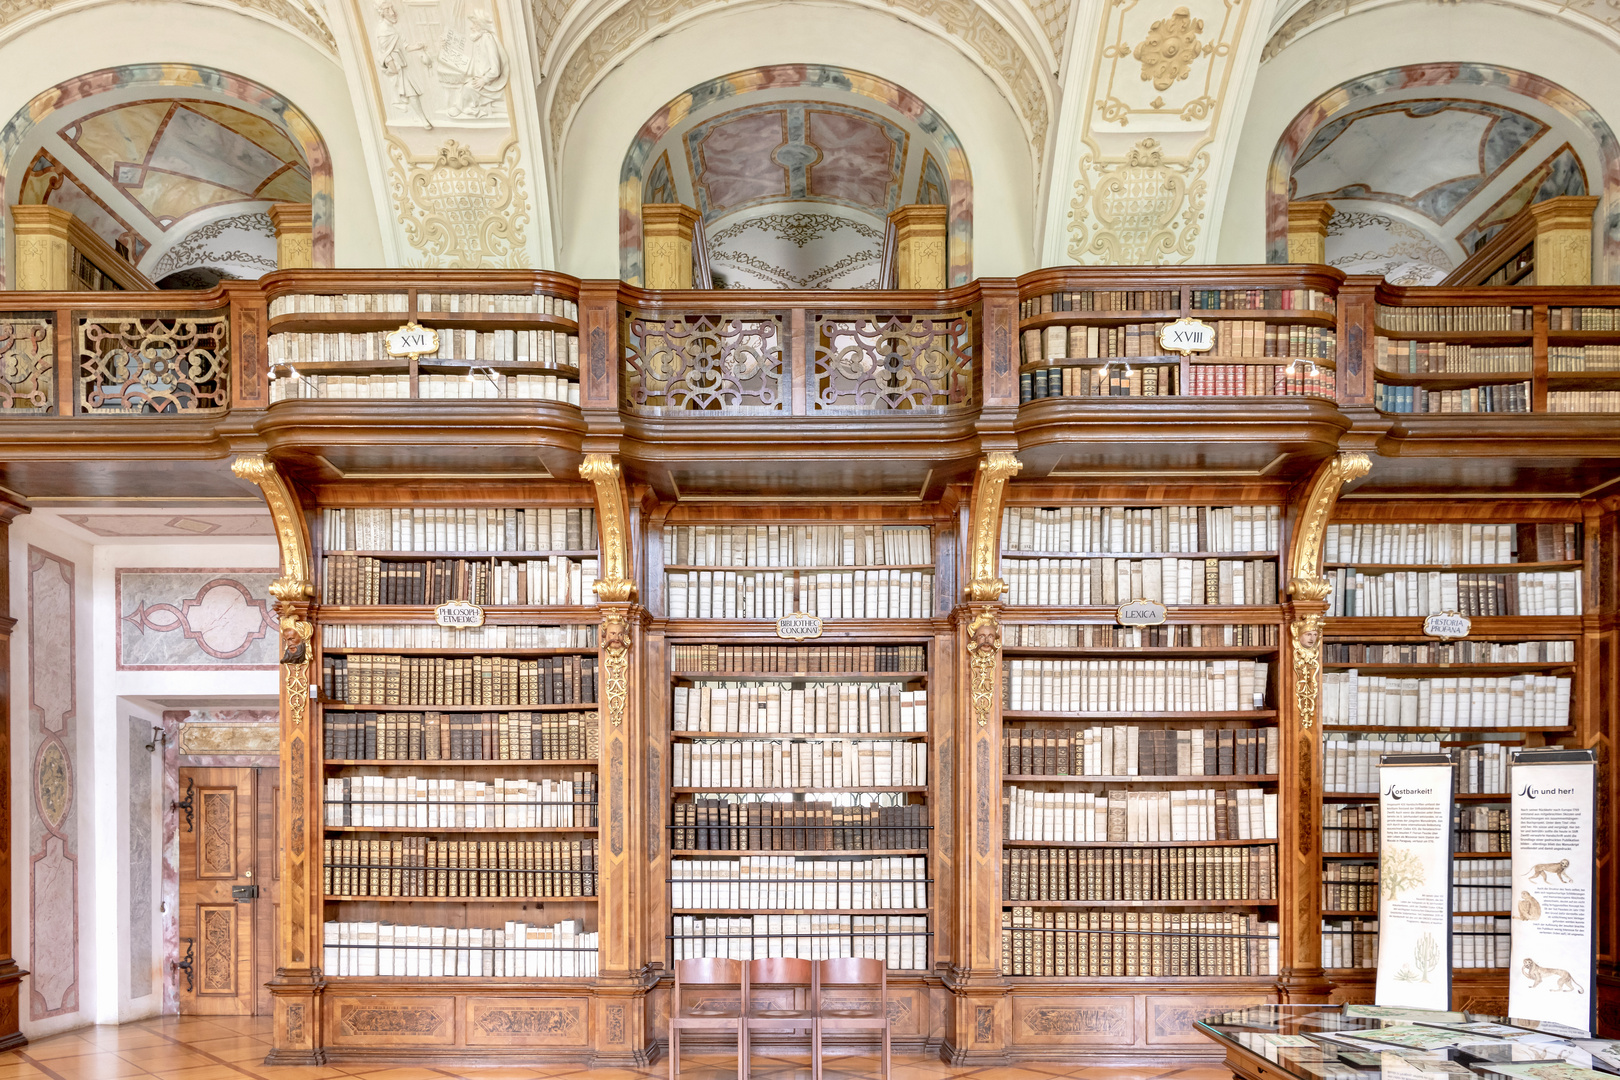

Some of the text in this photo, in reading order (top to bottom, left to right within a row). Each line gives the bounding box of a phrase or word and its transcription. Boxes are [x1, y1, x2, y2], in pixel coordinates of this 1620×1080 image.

[1125, 610, 1156, 619] LEXICA
[1430, 618, 1464, 627] HISTORIA
[1430, 625, 1461, 634] PROFANA
[1384, 784, 1433, 800] Kostbarkeit!
